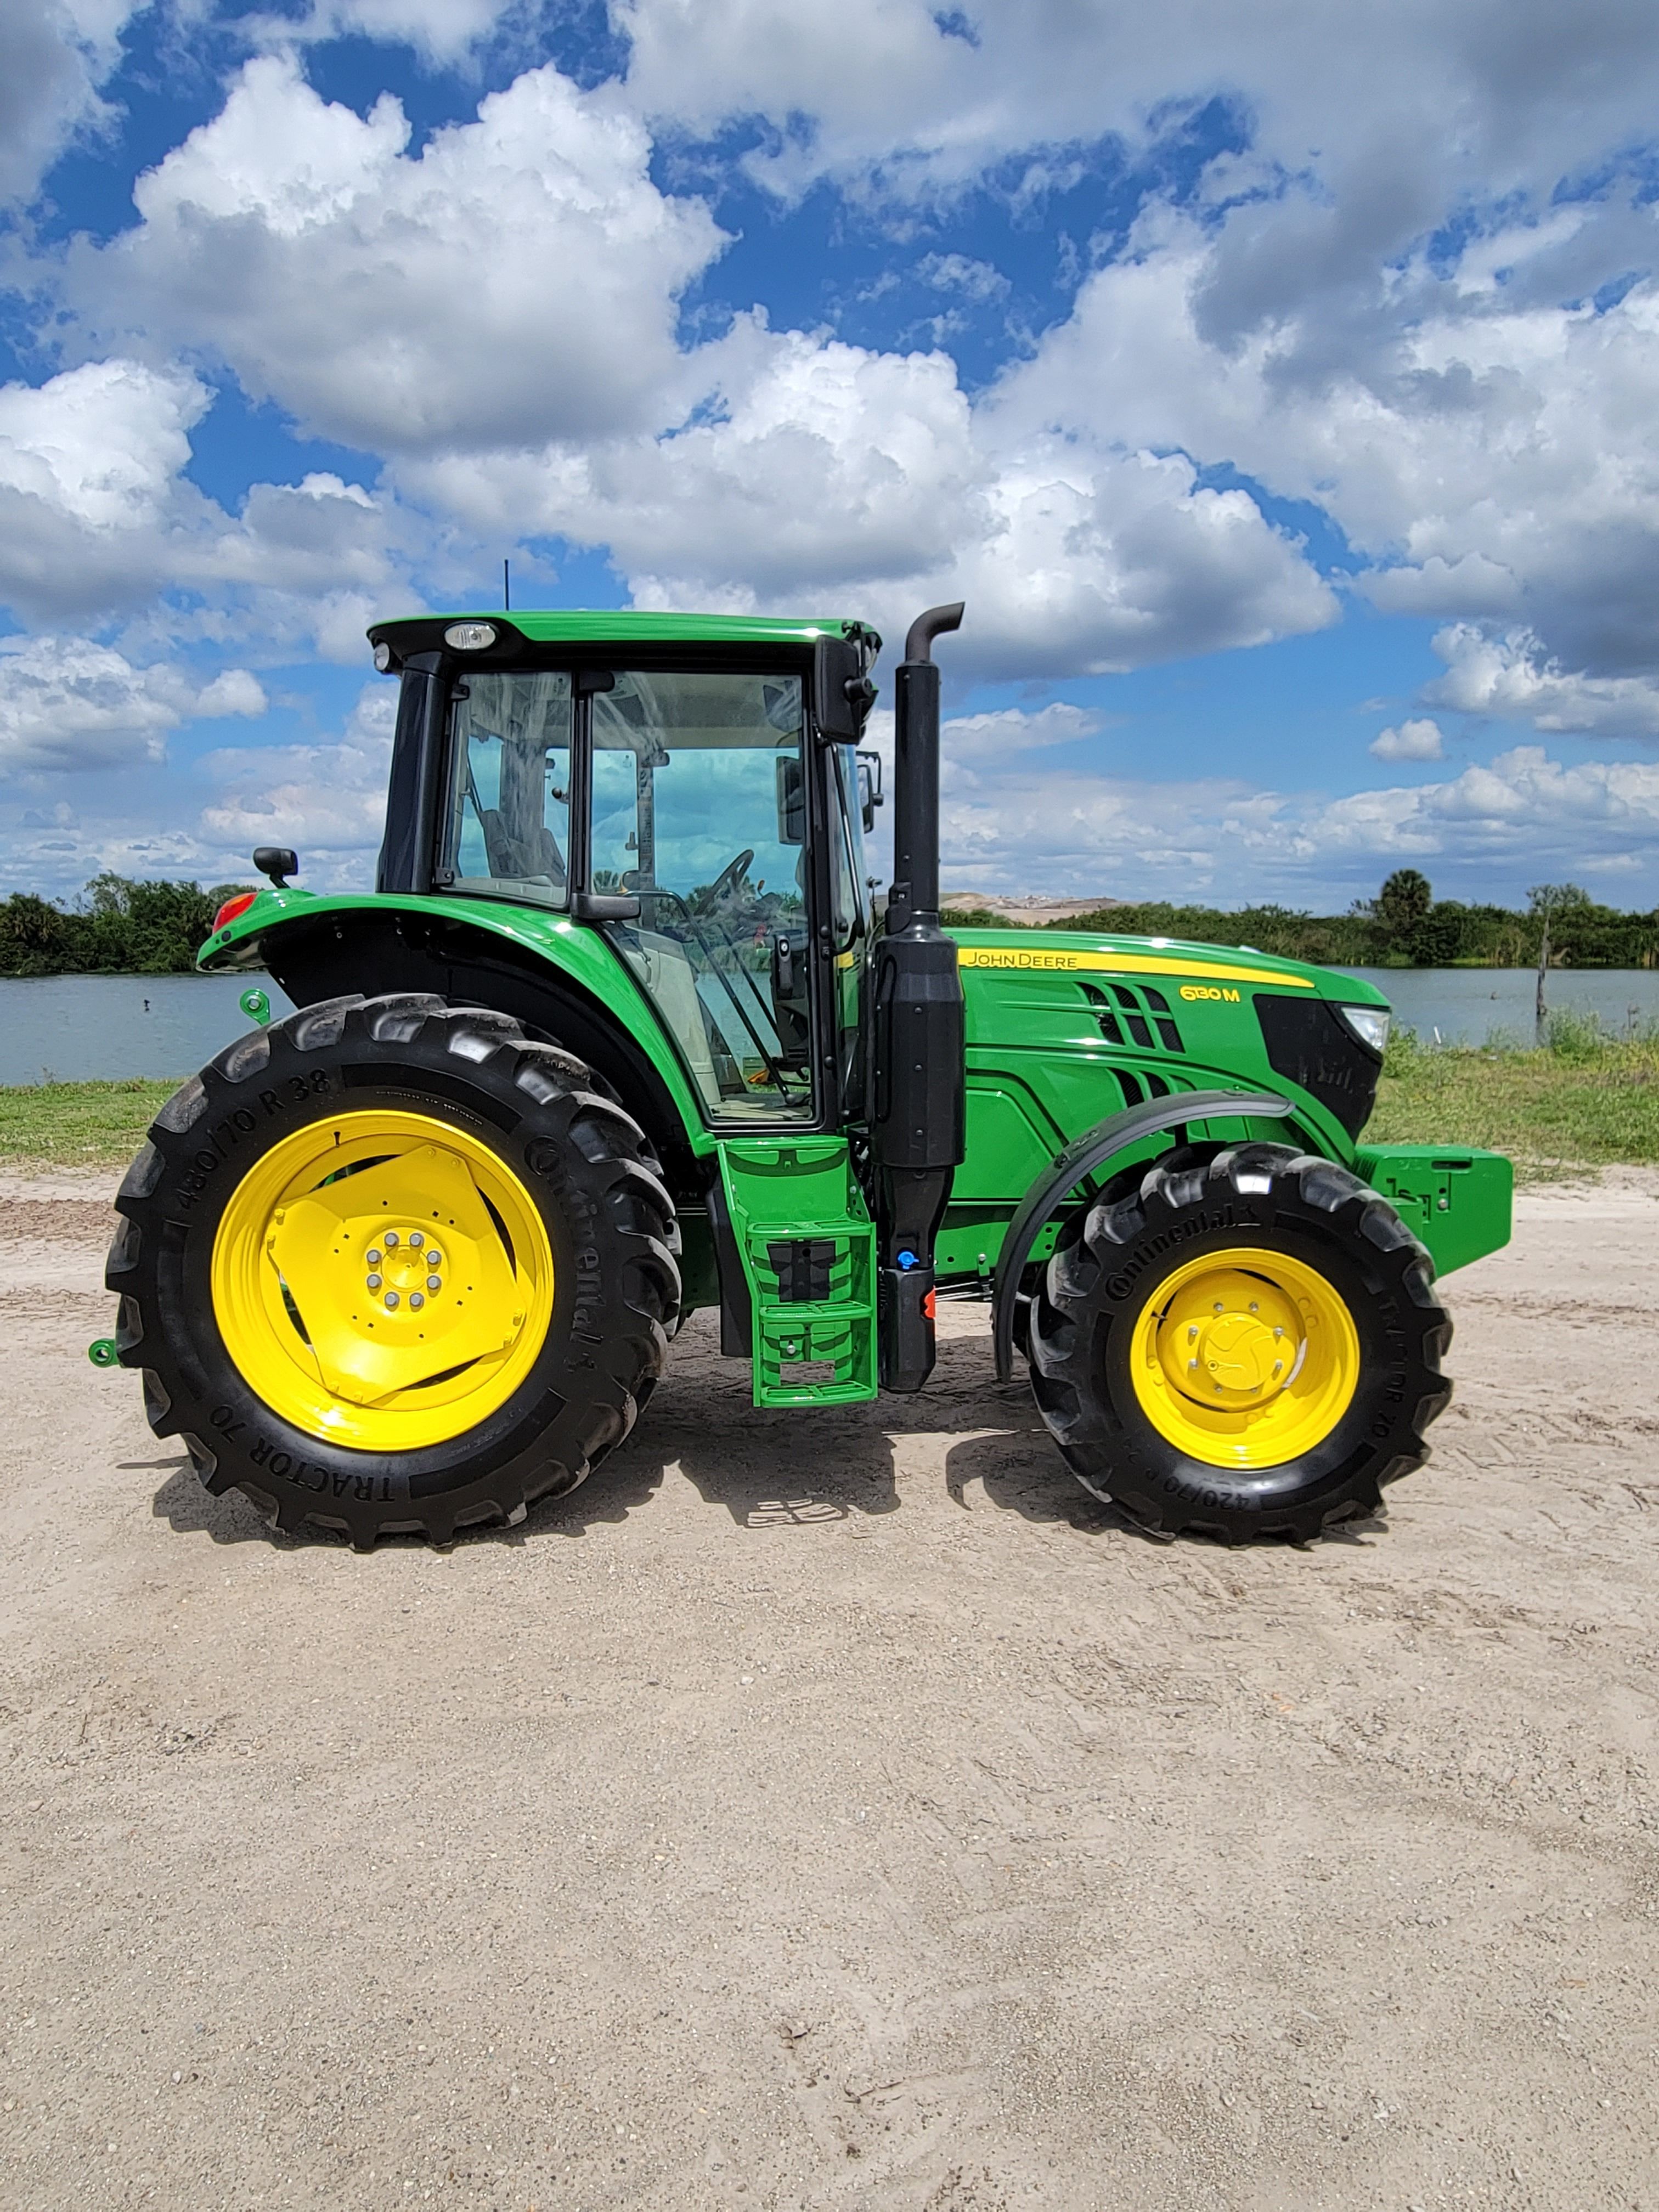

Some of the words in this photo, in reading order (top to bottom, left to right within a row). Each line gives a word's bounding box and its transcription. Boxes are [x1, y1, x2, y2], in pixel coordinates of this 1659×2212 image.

[968, 952, 1015, 966] JOHN
[1019, 953, 1077, 968] DEERE
[259, 1089, 286, 1115] R
[289, 1068, 331, 1101] 38
[1105, 1202, 1236, 1301] Continental
[208, 1405, 246, 1444] 70
[249, 1437, 395, 1502] TRACTOR
